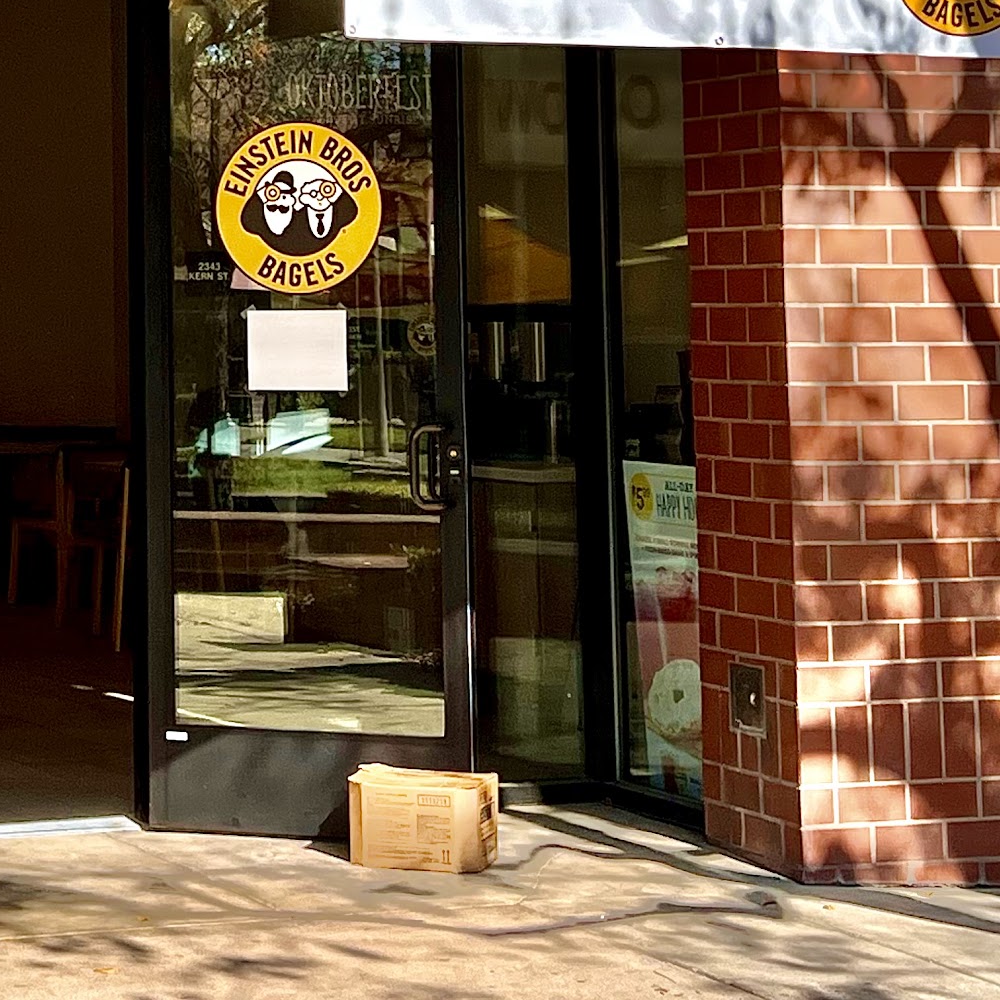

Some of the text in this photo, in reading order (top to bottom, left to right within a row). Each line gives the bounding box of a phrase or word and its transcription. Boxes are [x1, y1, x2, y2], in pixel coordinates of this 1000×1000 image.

[224, 130, 372, 197] EINSTEIN BROS
[188, 272, 229, 280] KERN ST
[258, 253, 345, 287] BAGELS
